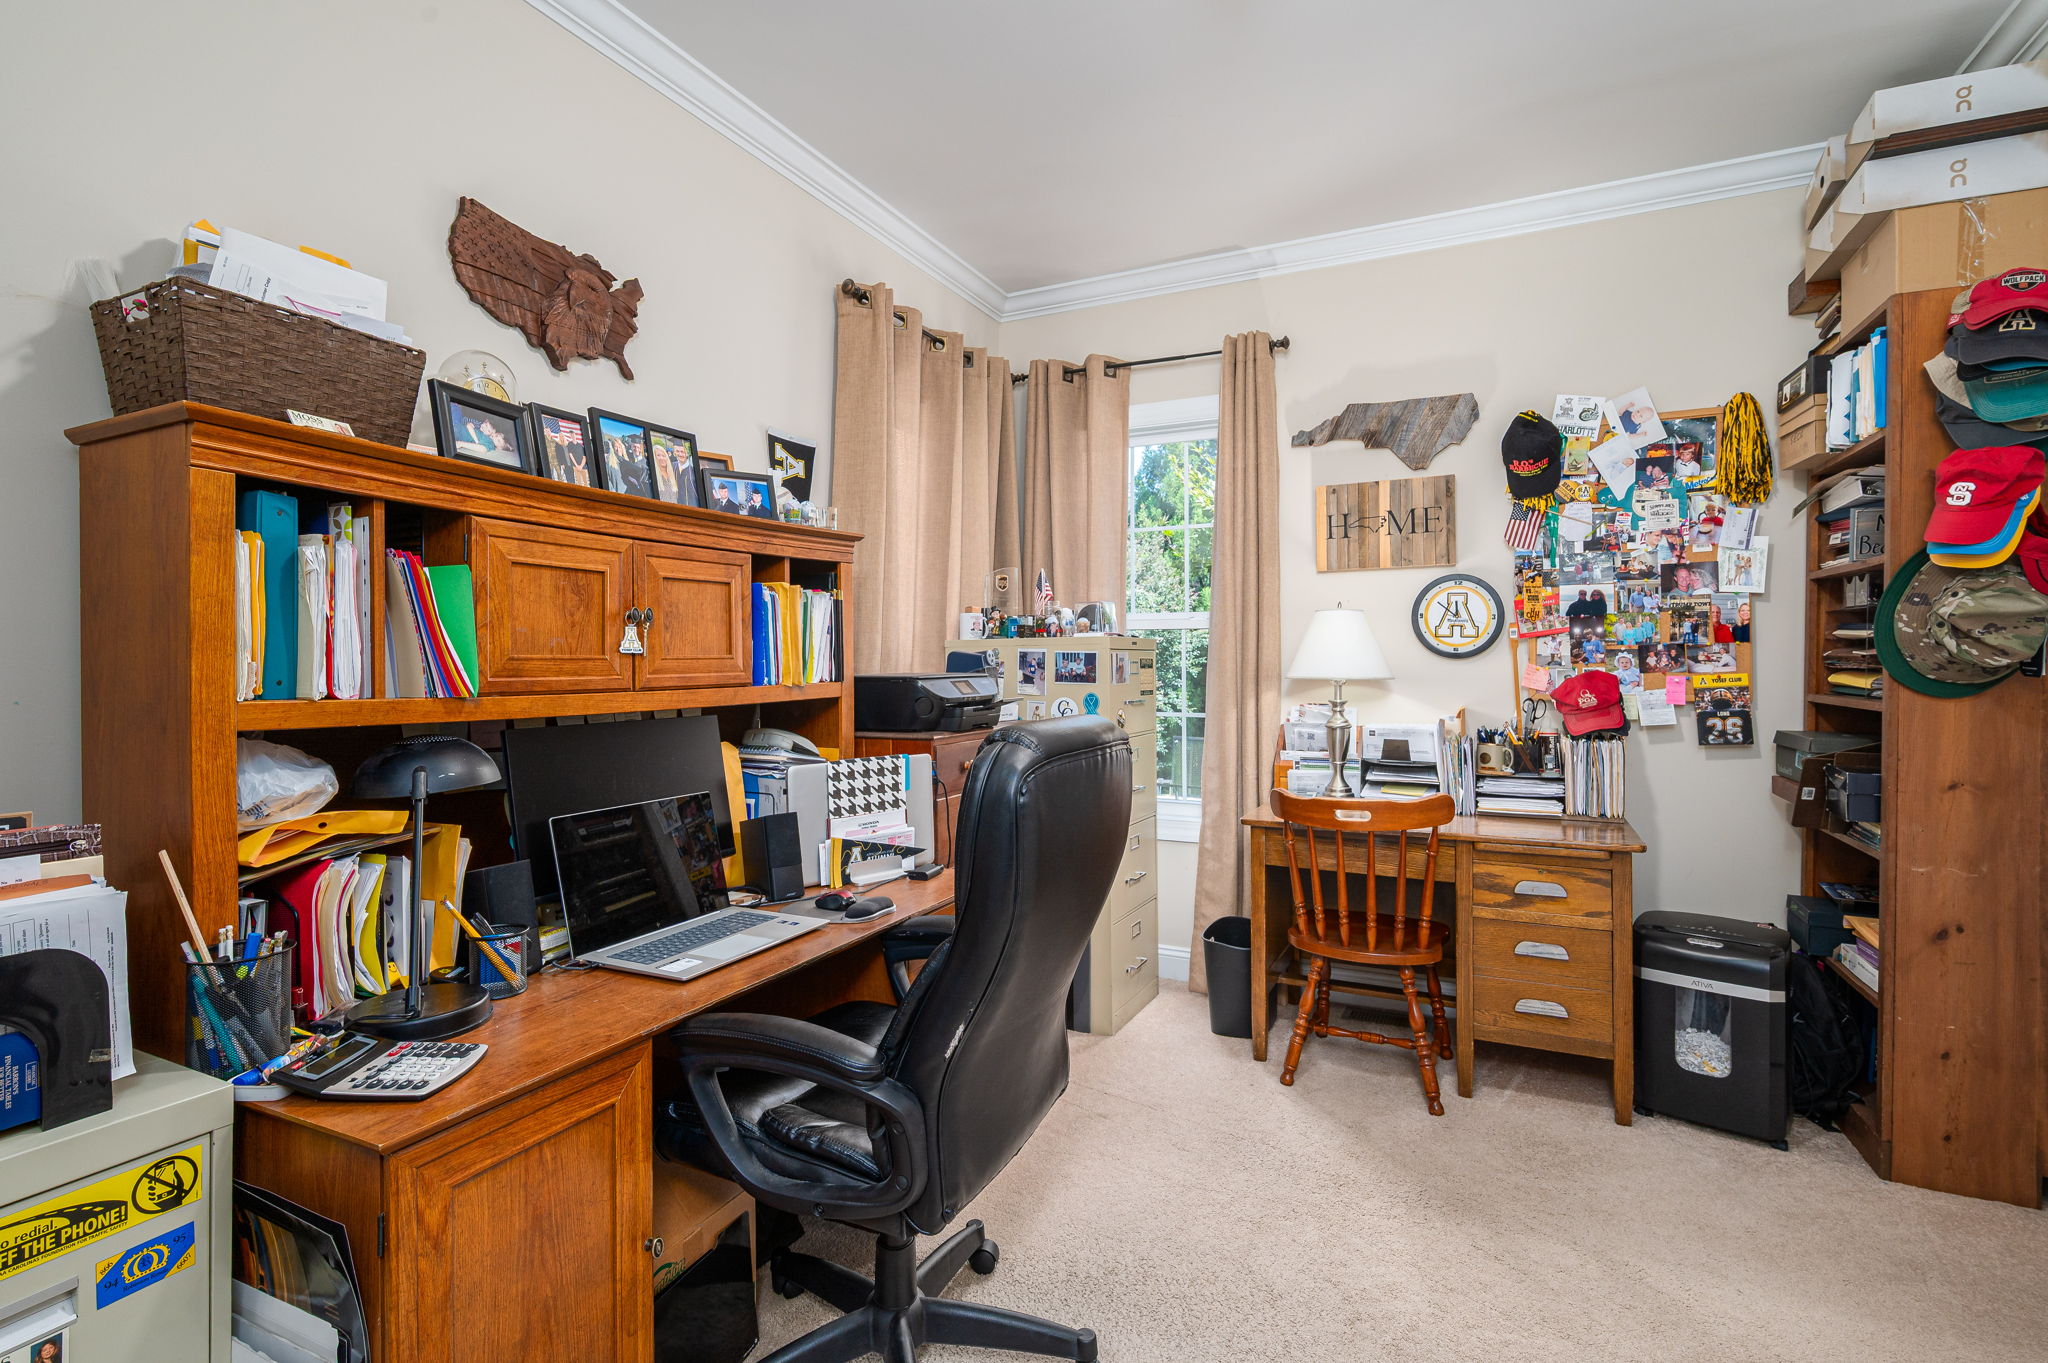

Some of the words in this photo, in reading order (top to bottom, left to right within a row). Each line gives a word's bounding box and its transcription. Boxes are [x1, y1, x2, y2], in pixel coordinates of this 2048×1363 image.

[2003, 275, 2045, 285] WOLFPACK
[291, 411, 323, 424] MOSS
[1558, 425, 1596, 439] HARLOTTE
[1691, 980, 1713, 990] ATIVA
[0, 1240, 9, 1249] o
[14, 1220, 58, 1244] redial.
[0, 1248, 18, 1269] FF
[21, 1233, 56, 1259] THE
[60, 1205, 126, 1244] PHONE!
[8, 1257, 40, 1273] CAROLINAS
[41, 1243, 76, 1259] FOUNDATION
[88, 1229, 109, 1240] TRAFFIC
[110, 1221, 128, 1231] SAFETY
[176, 1252, 191, 1270] 6607
